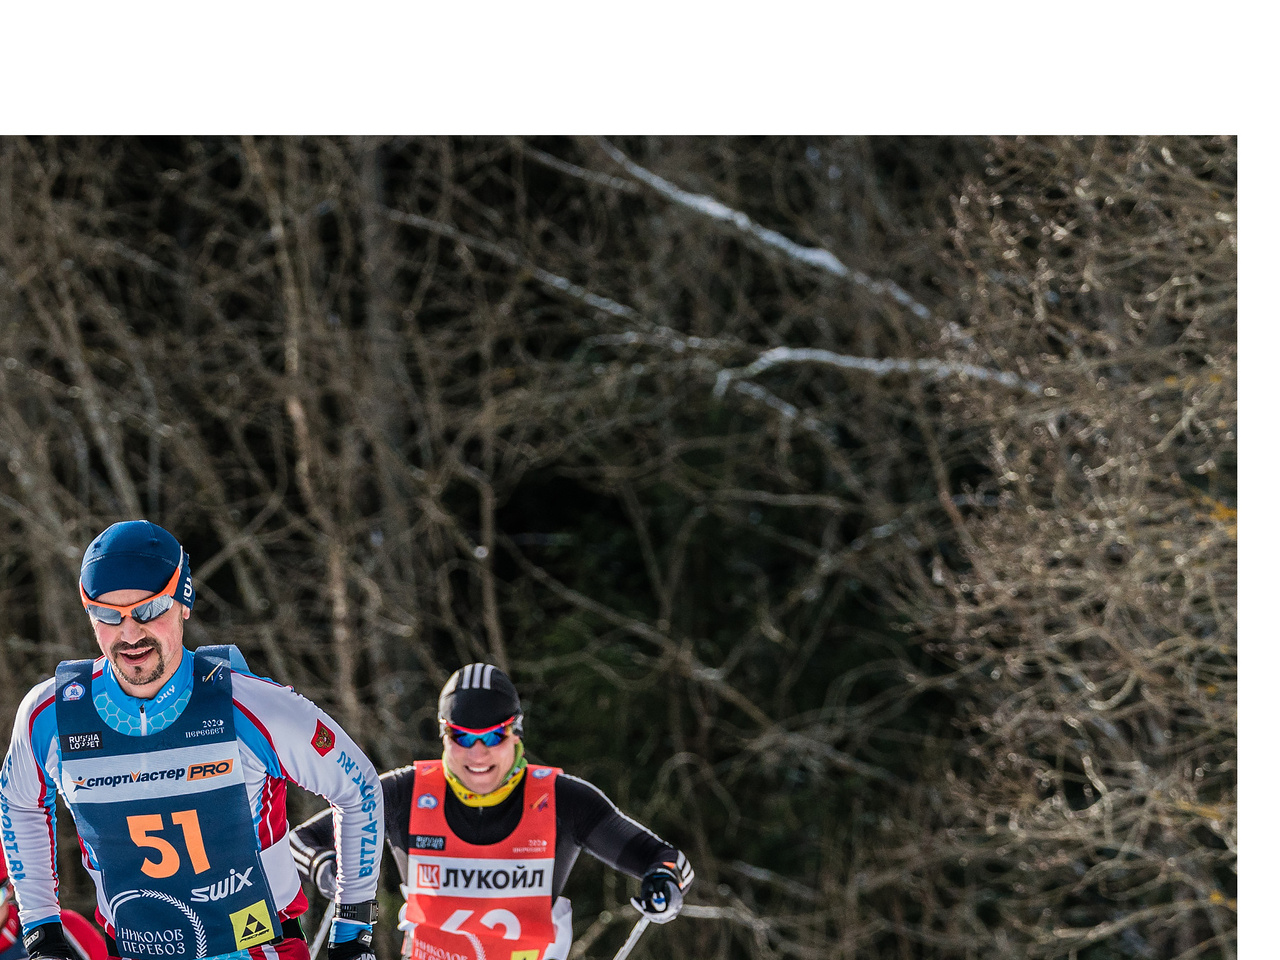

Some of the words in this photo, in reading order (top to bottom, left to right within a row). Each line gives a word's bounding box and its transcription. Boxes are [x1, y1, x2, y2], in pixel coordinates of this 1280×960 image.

[190, 762, 230, 779] PRO
[126, 809, 211, 879] 51
[443, 865, 544, 889] ЛУКОЙЛ
[121, 928, 184, 942] НИКОЛОВ
[122, 941, 185, 956] ПЕРЕВОЗ
